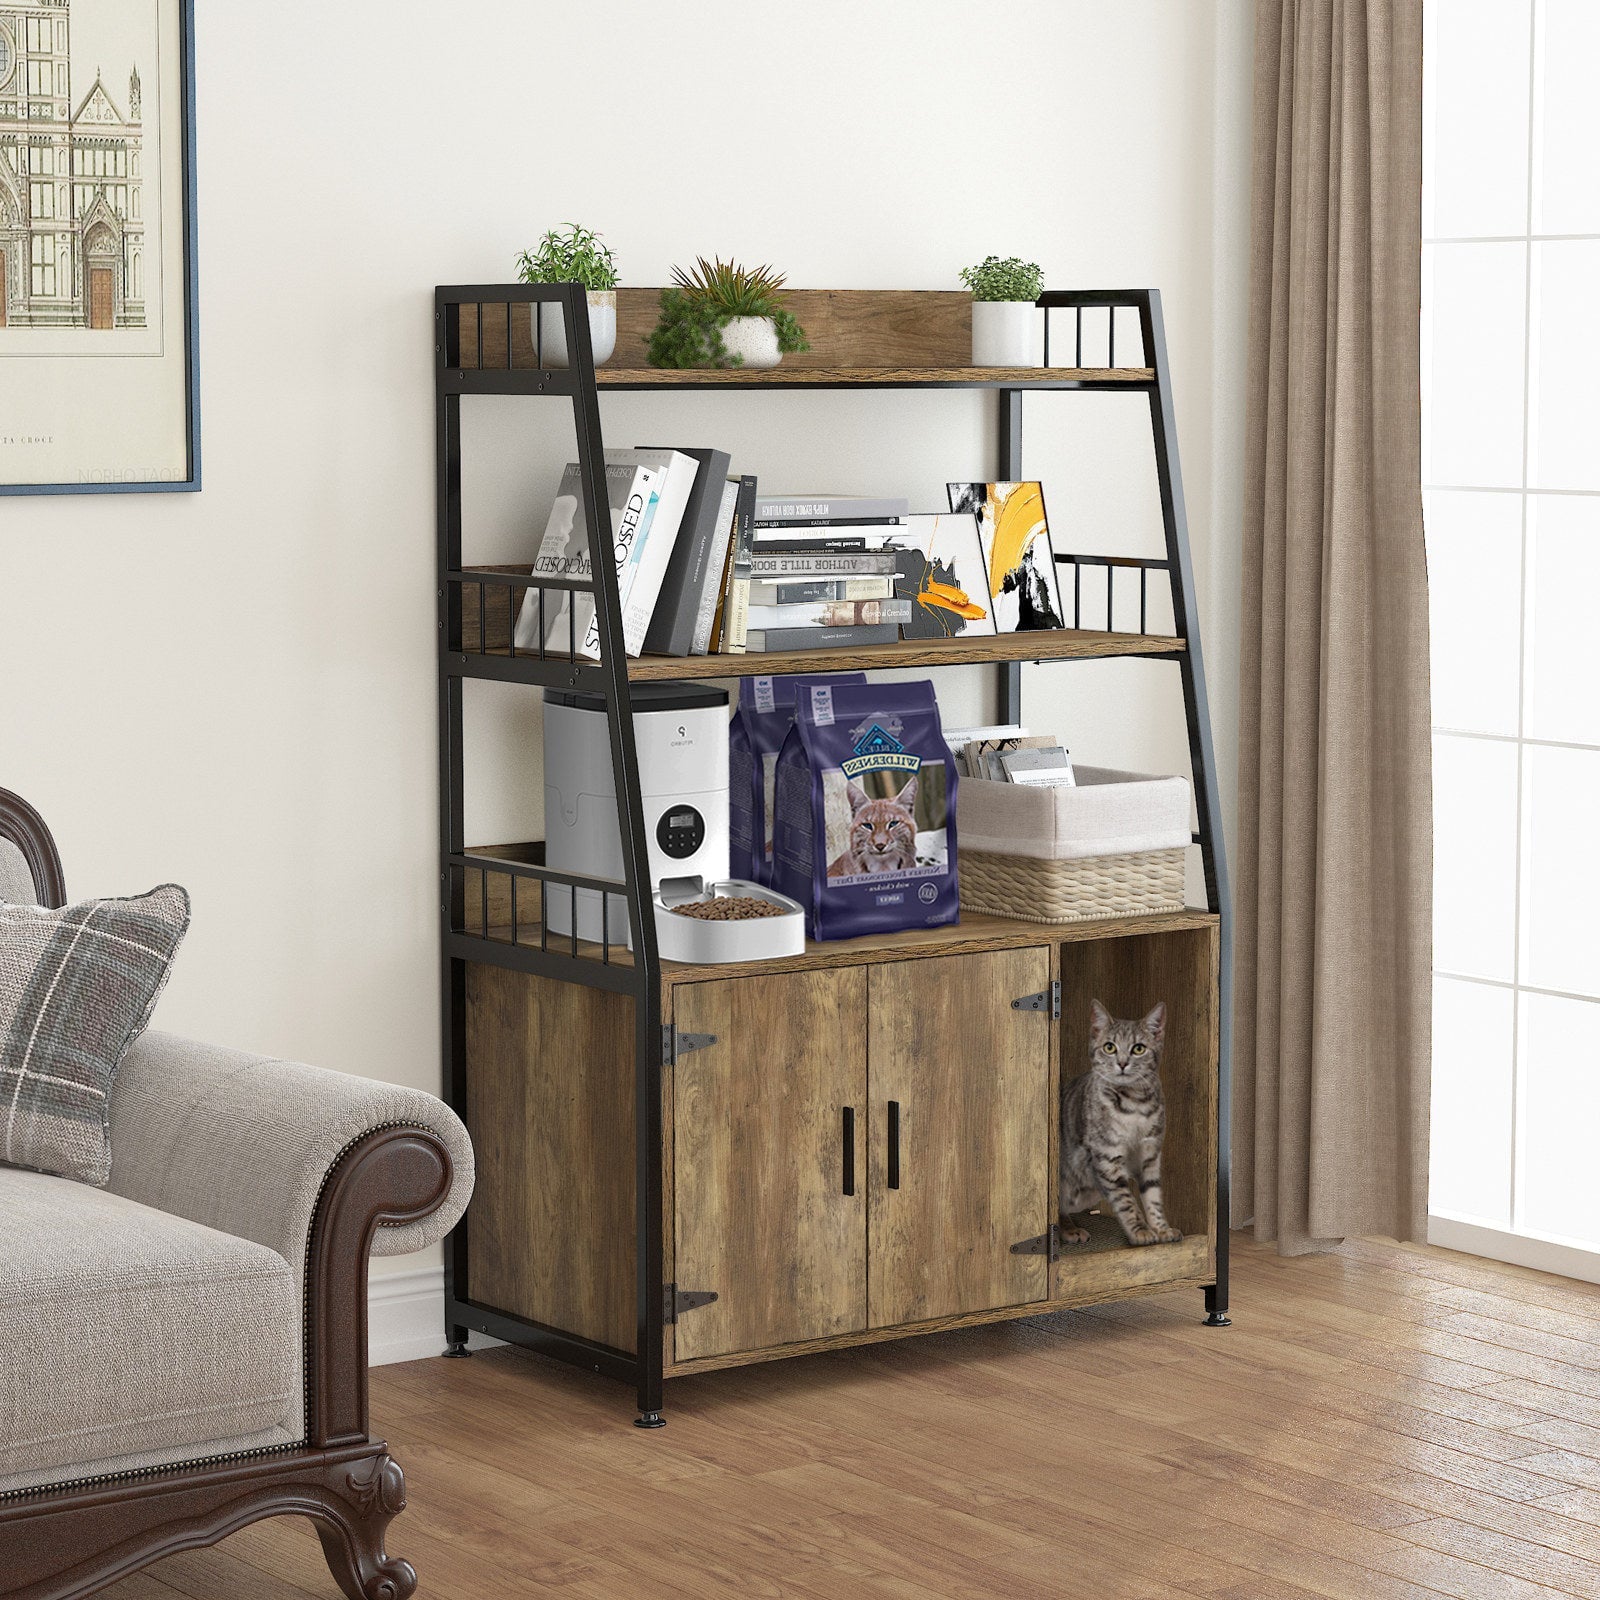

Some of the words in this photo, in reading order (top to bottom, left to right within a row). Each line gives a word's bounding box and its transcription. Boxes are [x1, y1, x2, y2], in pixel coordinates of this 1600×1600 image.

[751, 561, 776, 571] BOOK
[781, 560, 812, 570] TITLE
[815, 560, 858, 570] AUTHOR
